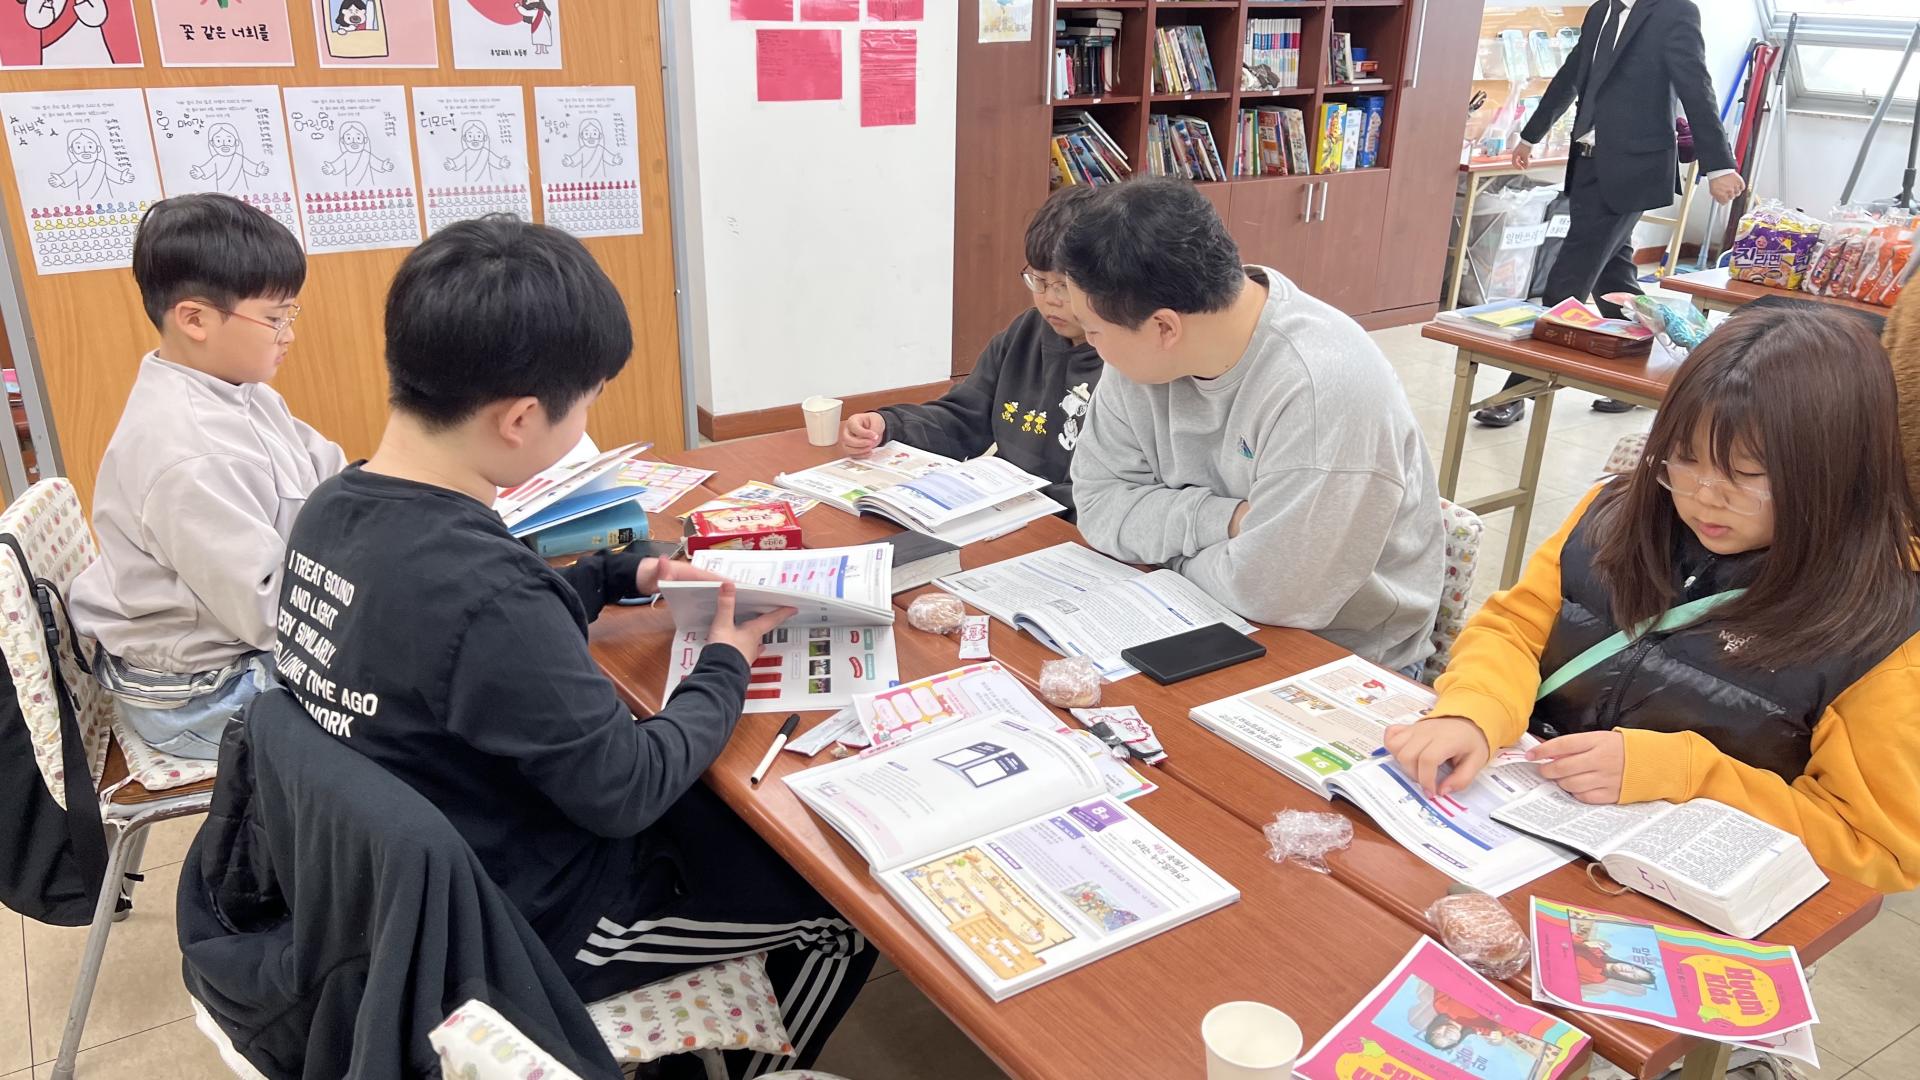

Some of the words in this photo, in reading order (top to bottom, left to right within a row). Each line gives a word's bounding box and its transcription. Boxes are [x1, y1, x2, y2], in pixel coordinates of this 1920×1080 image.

[179, 24, 195, 41] 꽃
[200, 25, 226, 41] 같은
[231, 24, 270, 42] 너희를
[420, 116, 456, 129] 디모데
[1733, 246, 1781, 267] 진라면
[287, 550, 296, 570] I
[294, 553, 326, 588] TREAT
[324, 570, 355, 607] SOUND
[278, 606, 298, 637] ERY
[289, 585, 312, 613] AND
[311, 597, 339, 631] LIGHT
[305, 669, 337, 703] TIME
[340, 688, 379, 717] AGO
[1723, 966, 1766, 1016] Huam
